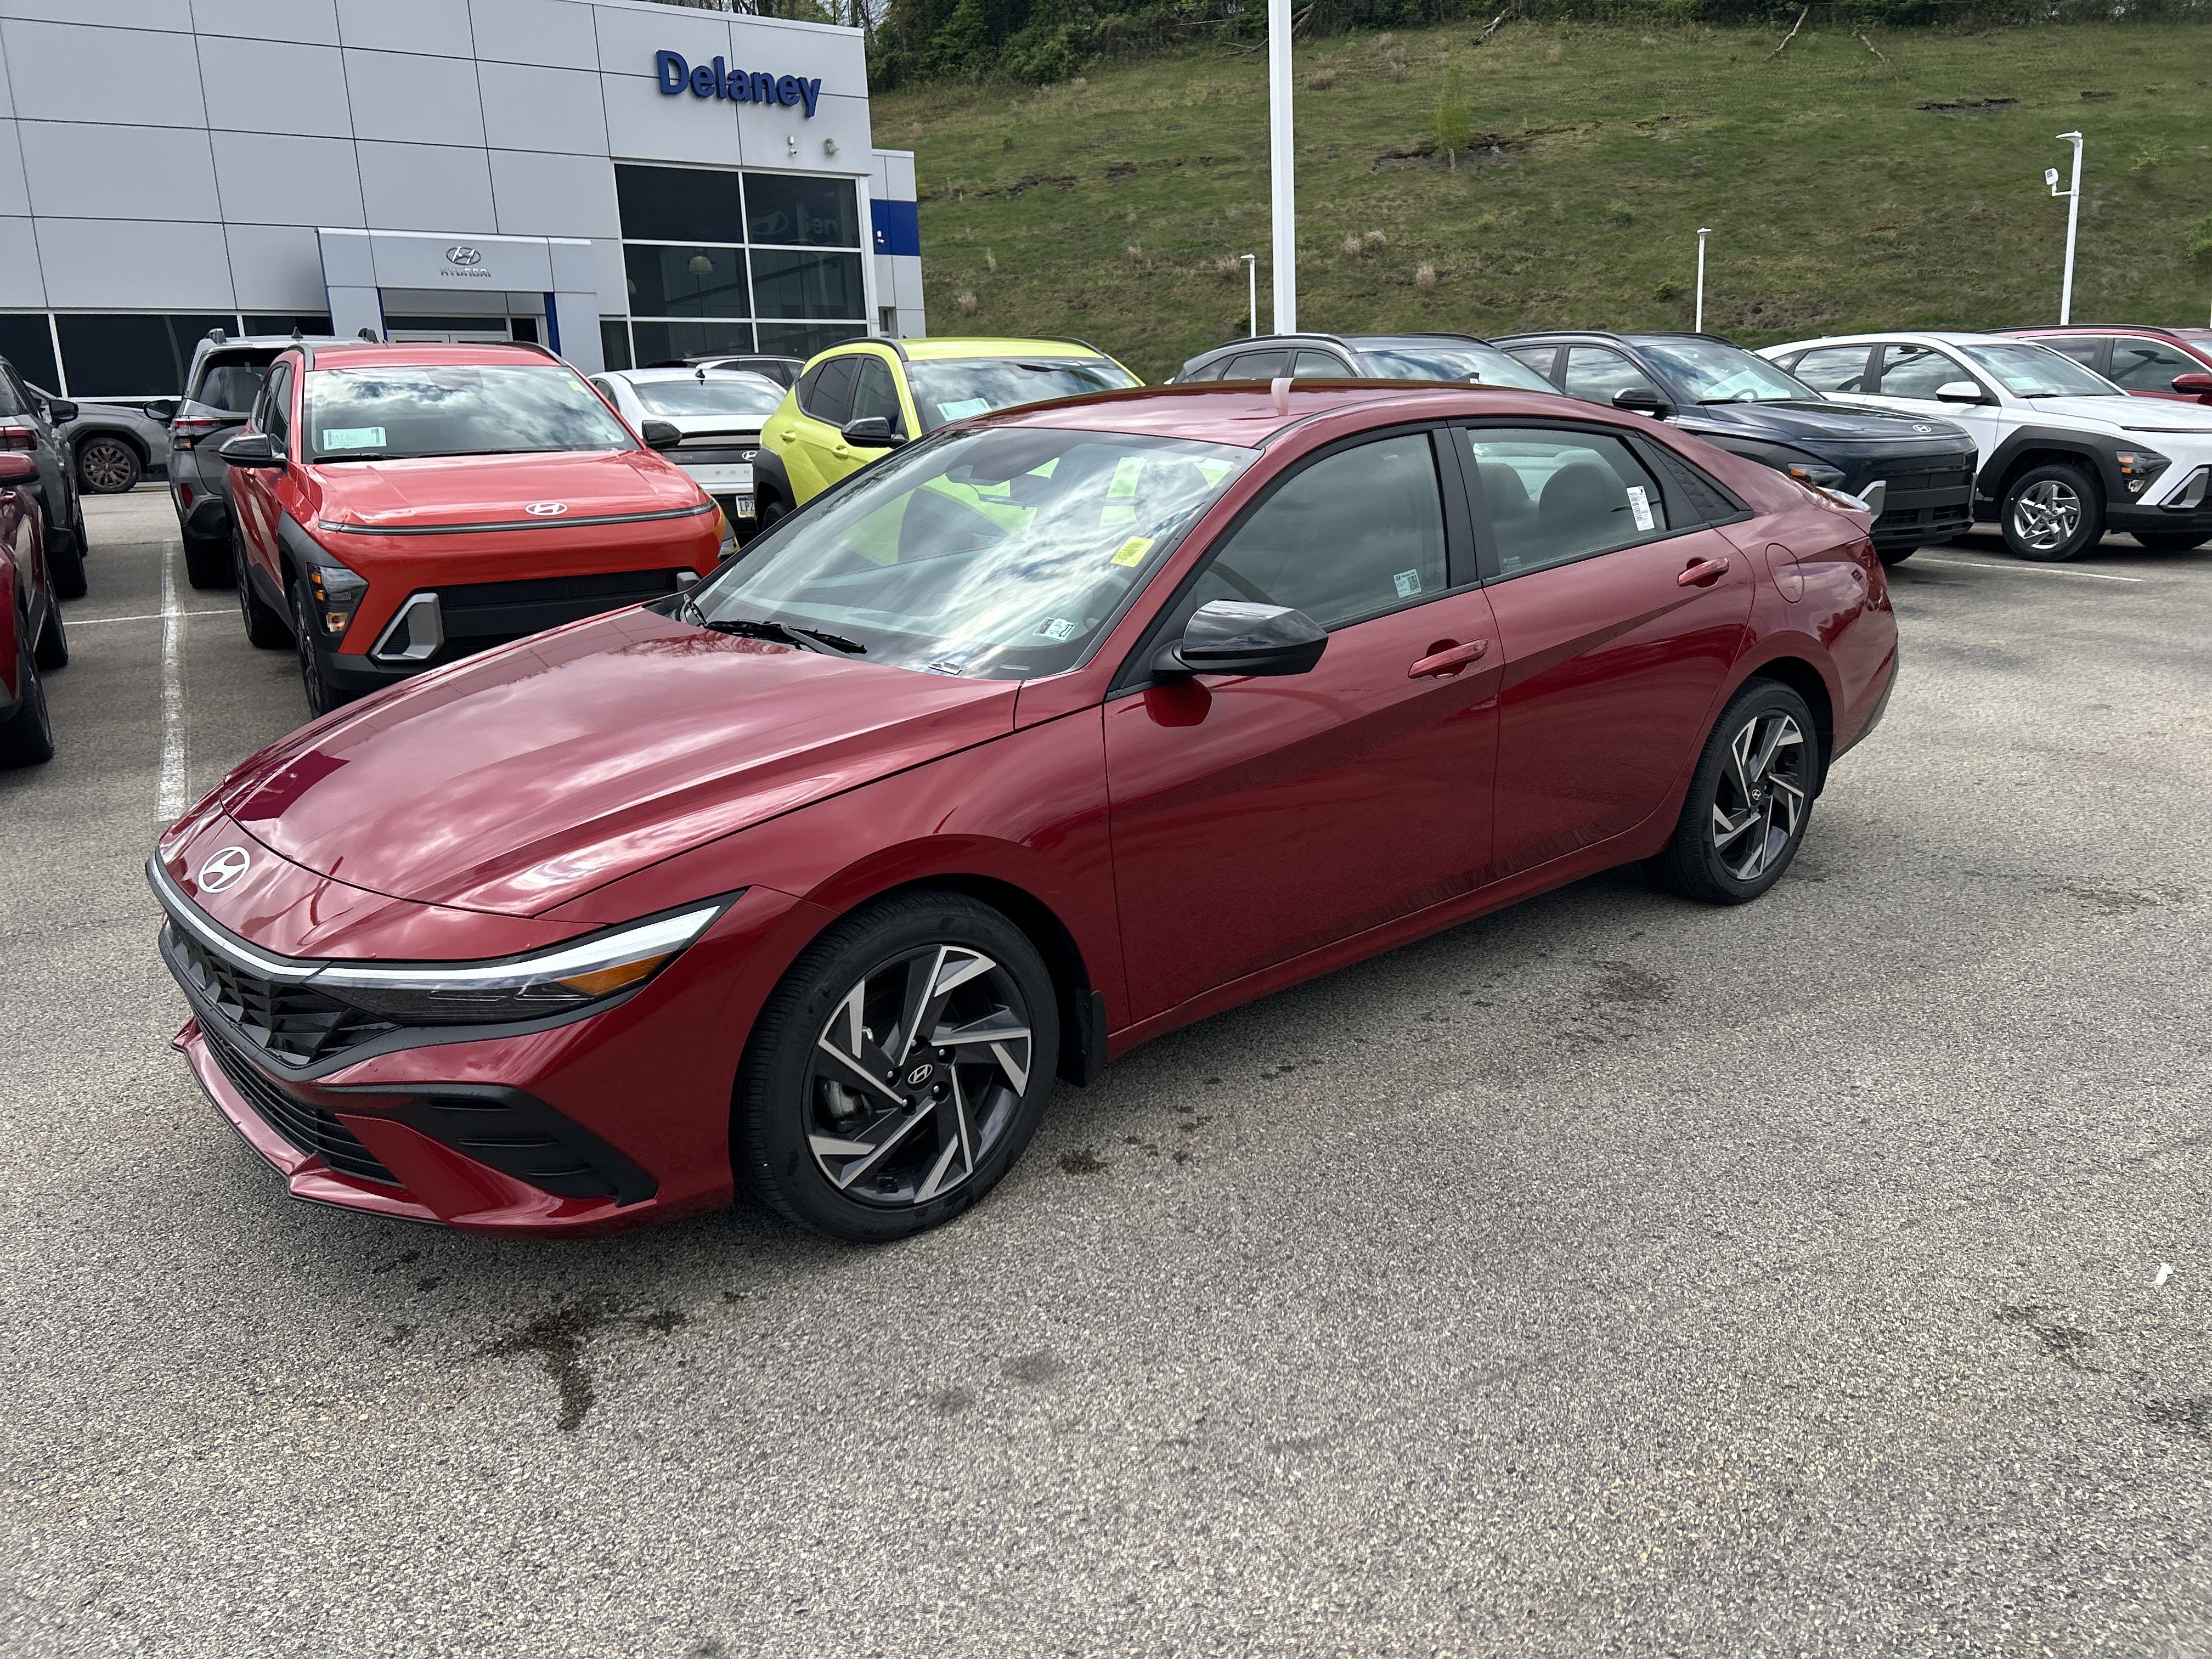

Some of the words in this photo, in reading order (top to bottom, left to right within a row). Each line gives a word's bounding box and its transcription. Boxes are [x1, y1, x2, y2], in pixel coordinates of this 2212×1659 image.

[656, 50, 821, 117] Delaney
[440, 267, 491, 277] HYUNDAI
[1058, 623, 1075, 638] 27
